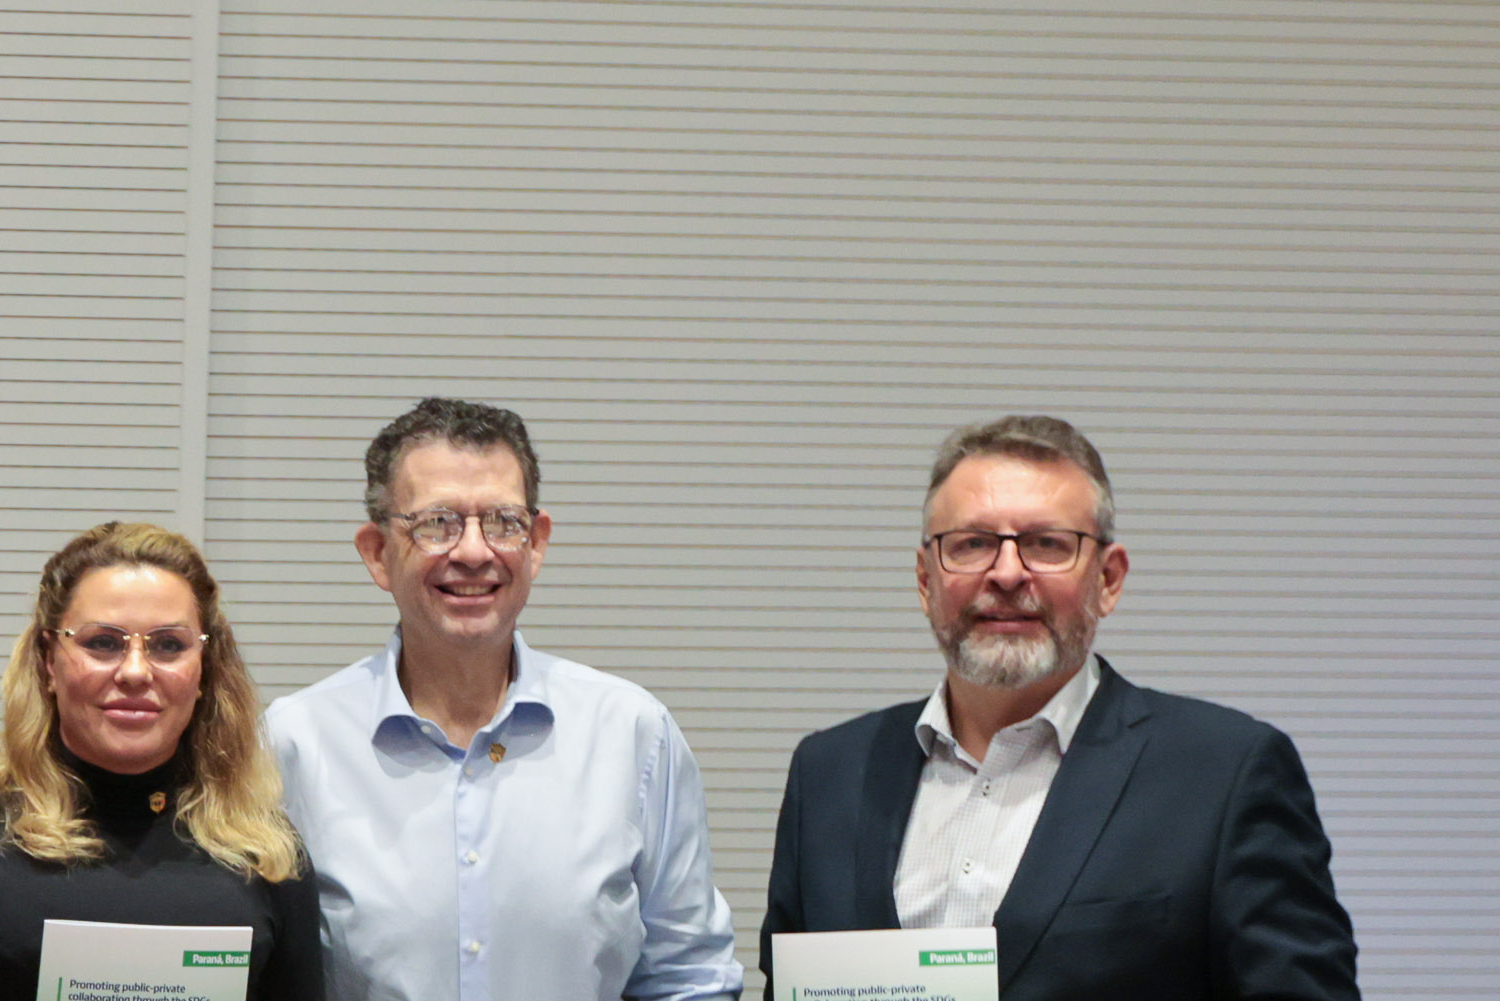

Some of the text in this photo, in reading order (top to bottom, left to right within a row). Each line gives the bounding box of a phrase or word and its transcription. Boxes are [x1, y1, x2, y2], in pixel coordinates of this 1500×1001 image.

[225, 954, 248, 964] Brazil
[967, 951, 994, 963] Brazil
[69, 979, 186, 994] Promoting public-private
[804, 984, 926, 998] Promoting public-private
